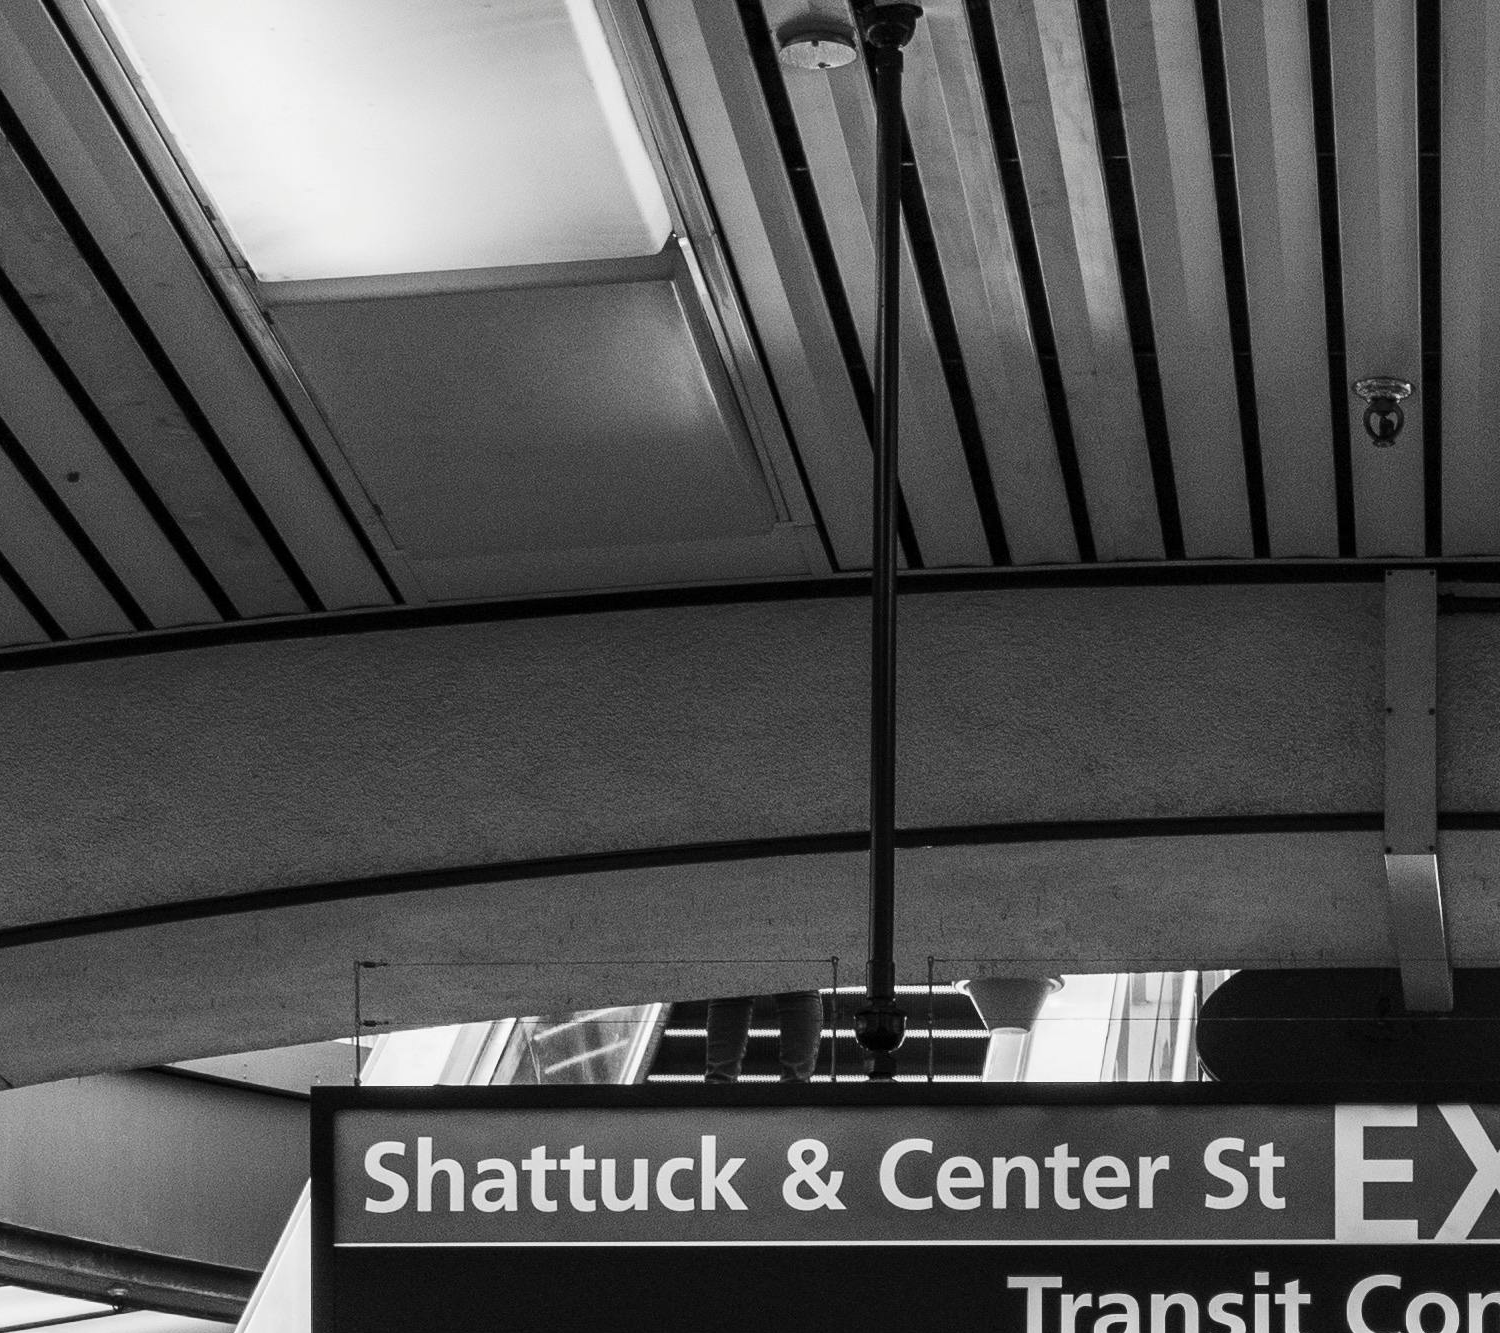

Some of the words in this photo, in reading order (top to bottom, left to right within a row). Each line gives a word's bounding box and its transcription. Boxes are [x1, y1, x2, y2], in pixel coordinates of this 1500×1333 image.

[363, 1135, 748, 1212] Shattuck
[782, 1137, 846, 1212] &
[879, 1137, 1169, 1211] Center
[1203, 1136, 1286, 1211] St
